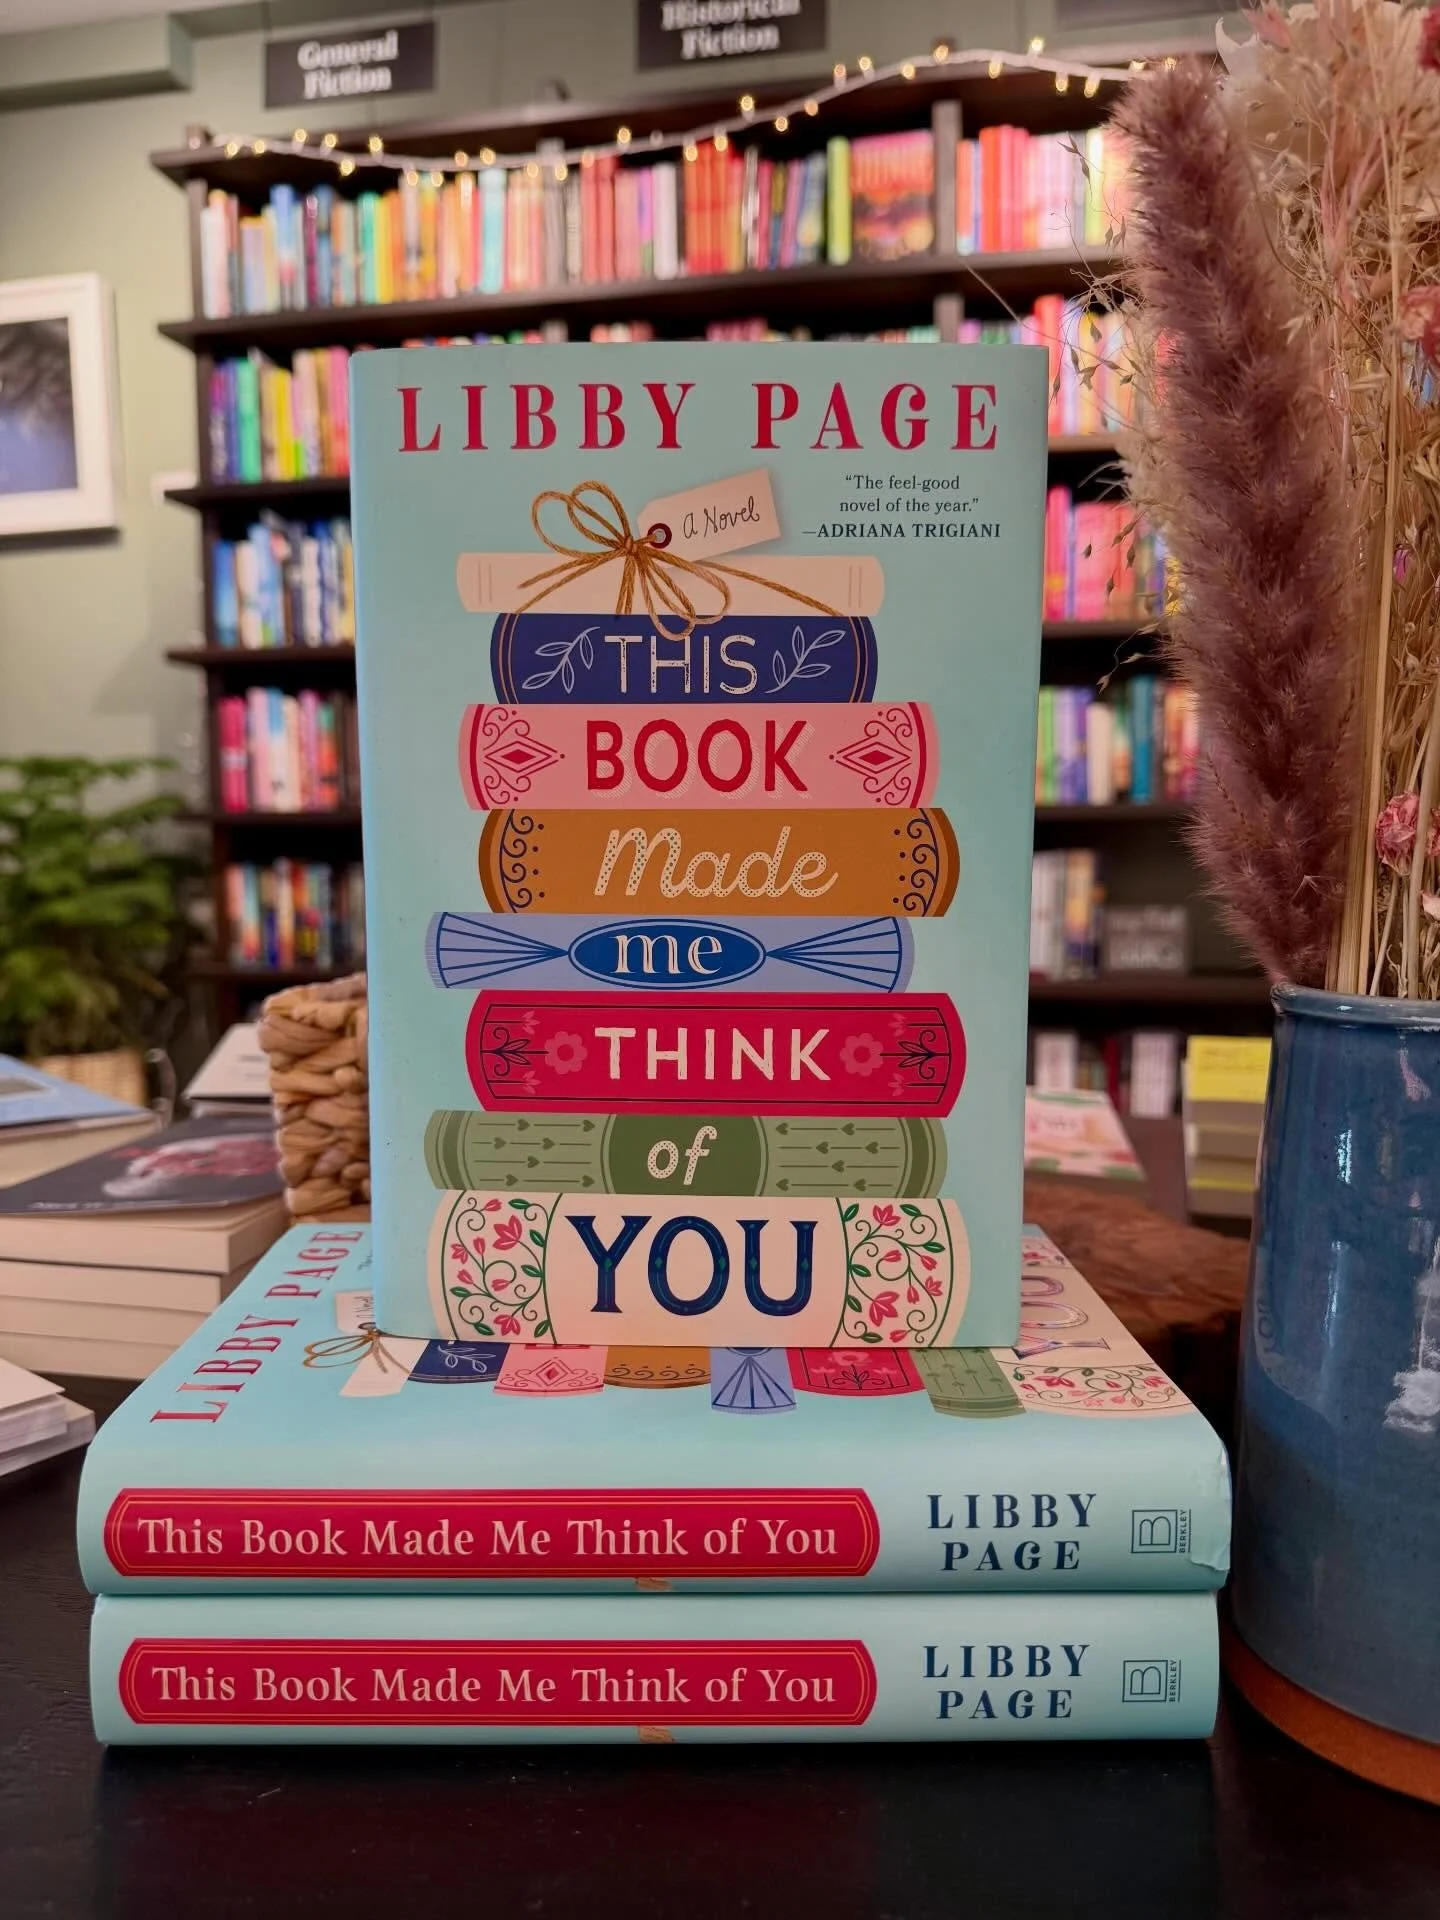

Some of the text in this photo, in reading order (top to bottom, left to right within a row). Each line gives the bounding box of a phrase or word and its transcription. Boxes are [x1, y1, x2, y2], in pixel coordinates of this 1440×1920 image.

[297, 29, 399, 70] General
[681, 22, 780, 60] Fiction
[303, 64, 392, 100] Fiction
[398, 382, 998, 452] LIBBY PAGE
[845, 475, 960, 494] “The feel-good
[703, 495, 761, 538] Novel
[840, 499, 979, 515] novel of the year.”
[912, 523, 1001, 538] TRIGIANI
[604, 635, 760, 695] THIS
[586, 718, 812, 799] BOOK
[594, 825, 839, 899] Made
[609, 932, 723, 975] me
[594, 1027, 832, 1082] THINK
[647, 1125, 718, 1186] of
[565, 1215, 819, 1317] YOU
[150, 1231, 363, 1424] LIBBY PAGE
[926, 1492, 1098, 1529] LIBBY
[1178, 1508, 1188, 1554] BERKLEY
[137, 1517, 838, 1556] This Book Made Me Think of You
[940, 1540, 1081, 1571] PAGE
[922, 1643, 1091, 1679] LIBBY
[1169, 1659, 1177, 1702] BERKLEY
[151, 1665, 836, 1704] This Book Made Me Think of You
[936, 1689, 1073, 1720] PAGE
